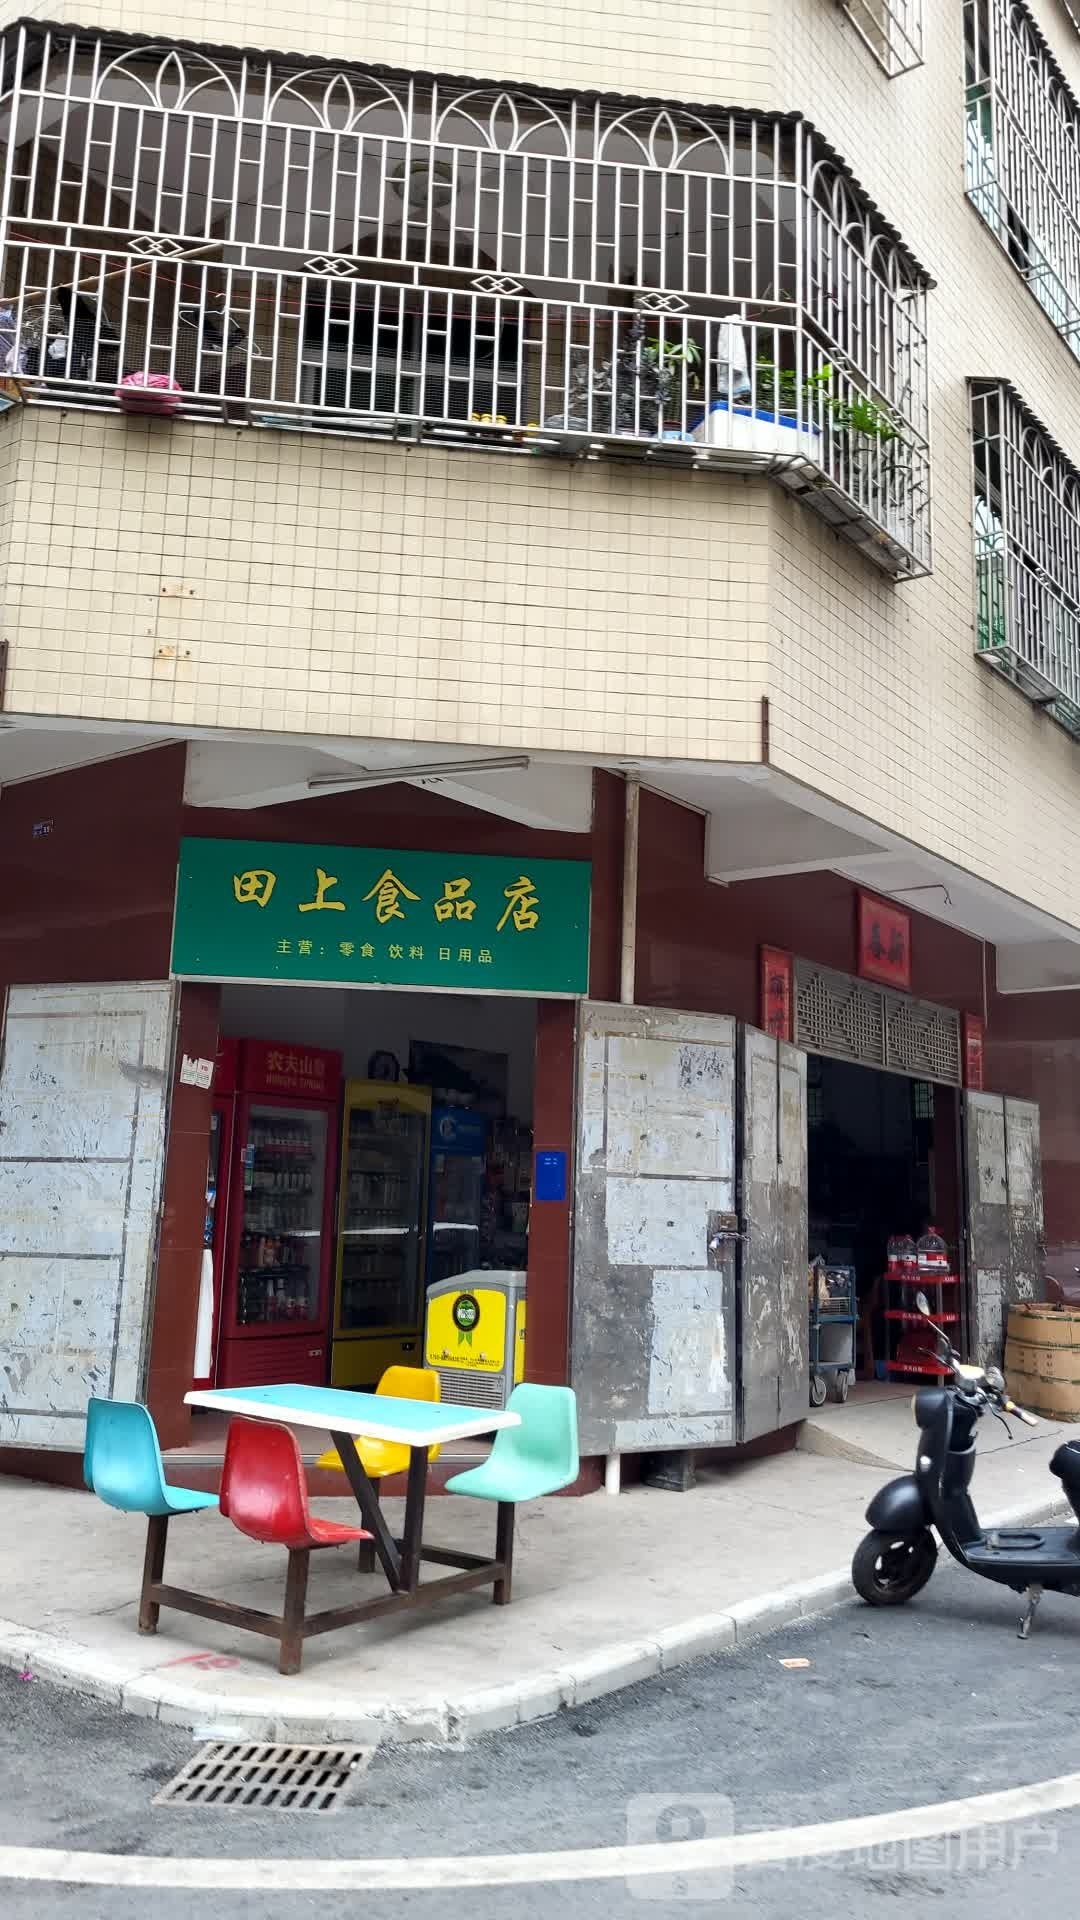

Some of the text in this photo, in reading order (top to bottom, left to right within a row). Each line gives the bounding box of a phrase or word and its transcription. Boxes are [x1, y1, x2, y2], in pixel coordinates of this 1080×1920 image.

[232, 868, 541, 932] 田上食品店
[339, 941, 375, 958] 零食
[388, 943, 424, 960] 饮料
[438, 947, 493, 963] 日用品
